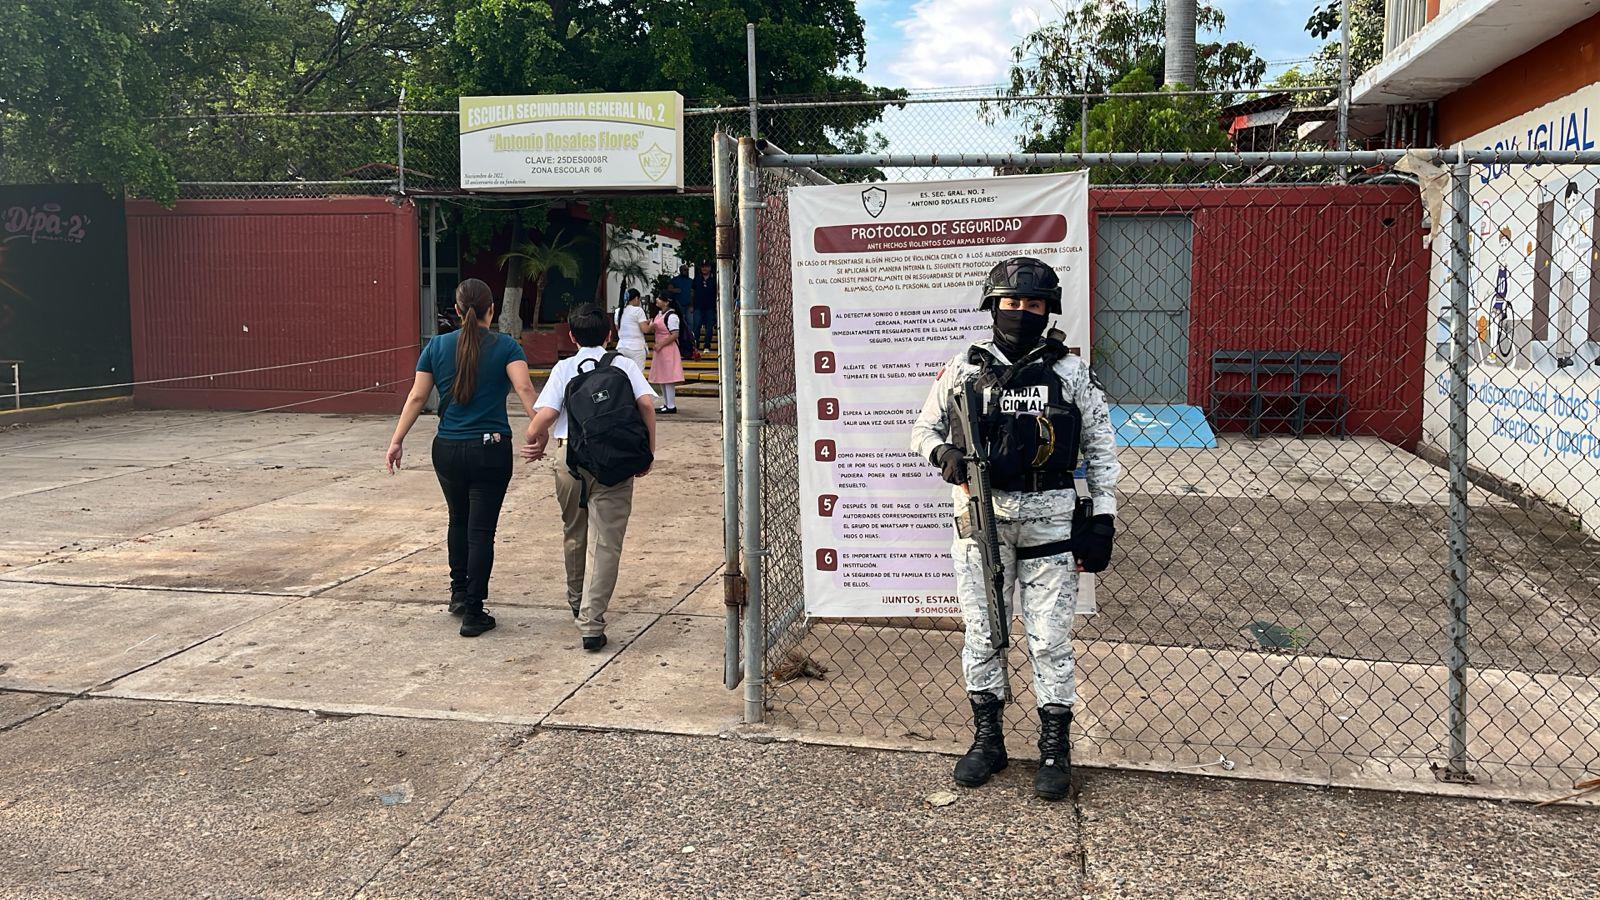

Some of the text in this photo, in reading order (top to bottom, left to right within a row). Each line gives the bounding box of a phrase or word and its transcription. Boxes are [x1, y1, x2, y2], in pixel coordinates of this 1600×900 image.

[468, 102, 665, 127] ESCUELA SECUNDARIA GENERAL No. 2
[546, 133, 597, 151] Rosales
[1524, 107, 1595, 170] IGUAL
[557, 156, 608, 164] 25DES0008R
[852, 218, 1022, 239] PROTOCOLO DE SEGURIDAD
[820, 313, 825, 324] 1
[821, 357, 829, 368] 2
[1480, 378, 1548, 412] discapacidad
[1553, 386, 1588, 421] todos
[826, 402, 833, 414] 3
[1492, 409, 1540, 445] derechos
[1543, 426, 1552, 458] y
[821, 446, 829, 458] 4
[824, 499, 831, 511] 5
[824, 552, 832, 564] 6
